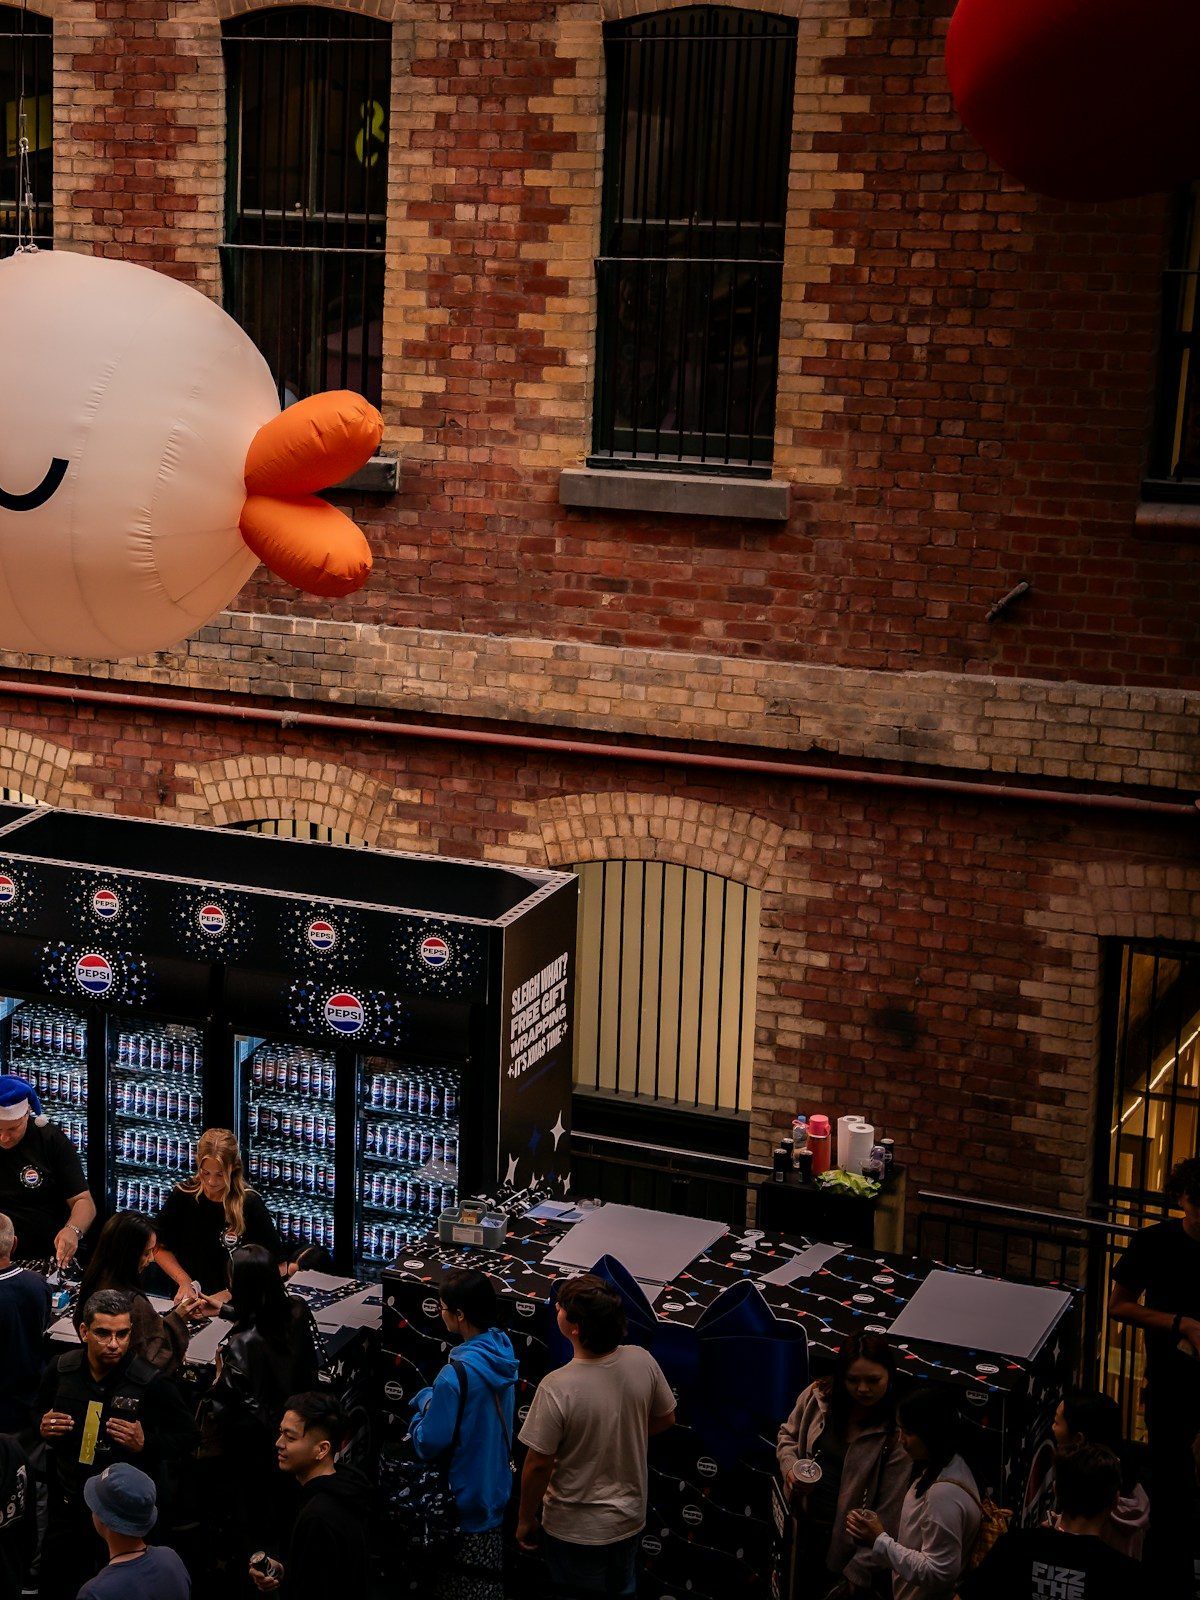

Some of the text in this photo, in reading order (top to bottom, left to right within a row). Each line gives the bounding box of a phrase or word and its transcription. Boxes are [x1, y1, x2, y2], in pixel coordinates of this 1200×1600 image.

[95, 900, 117, 908] PEPSI
[201, 915, 224, 924] PEPSI
[310, 931, 334, 940] PEPSI
[423, 947, 447, 957] PEPSI
[78, 968, 110, 981] PEPSI
[511, 951, 569, 1015] SLEIGH WHAT?
[327, 1007, 362, 1021] PEPSI
[511, 977, 568, 1040] FREE GIFT
[511, 1002, 566, 1058] WRAPPING
[527, 1037, 546, 1069] XMAS
[546, 1023, 561, 1052] TIME
[1032, 1560, 1086, 1587] FIZZ
[1031, 1575, 1086, 1600] THE
